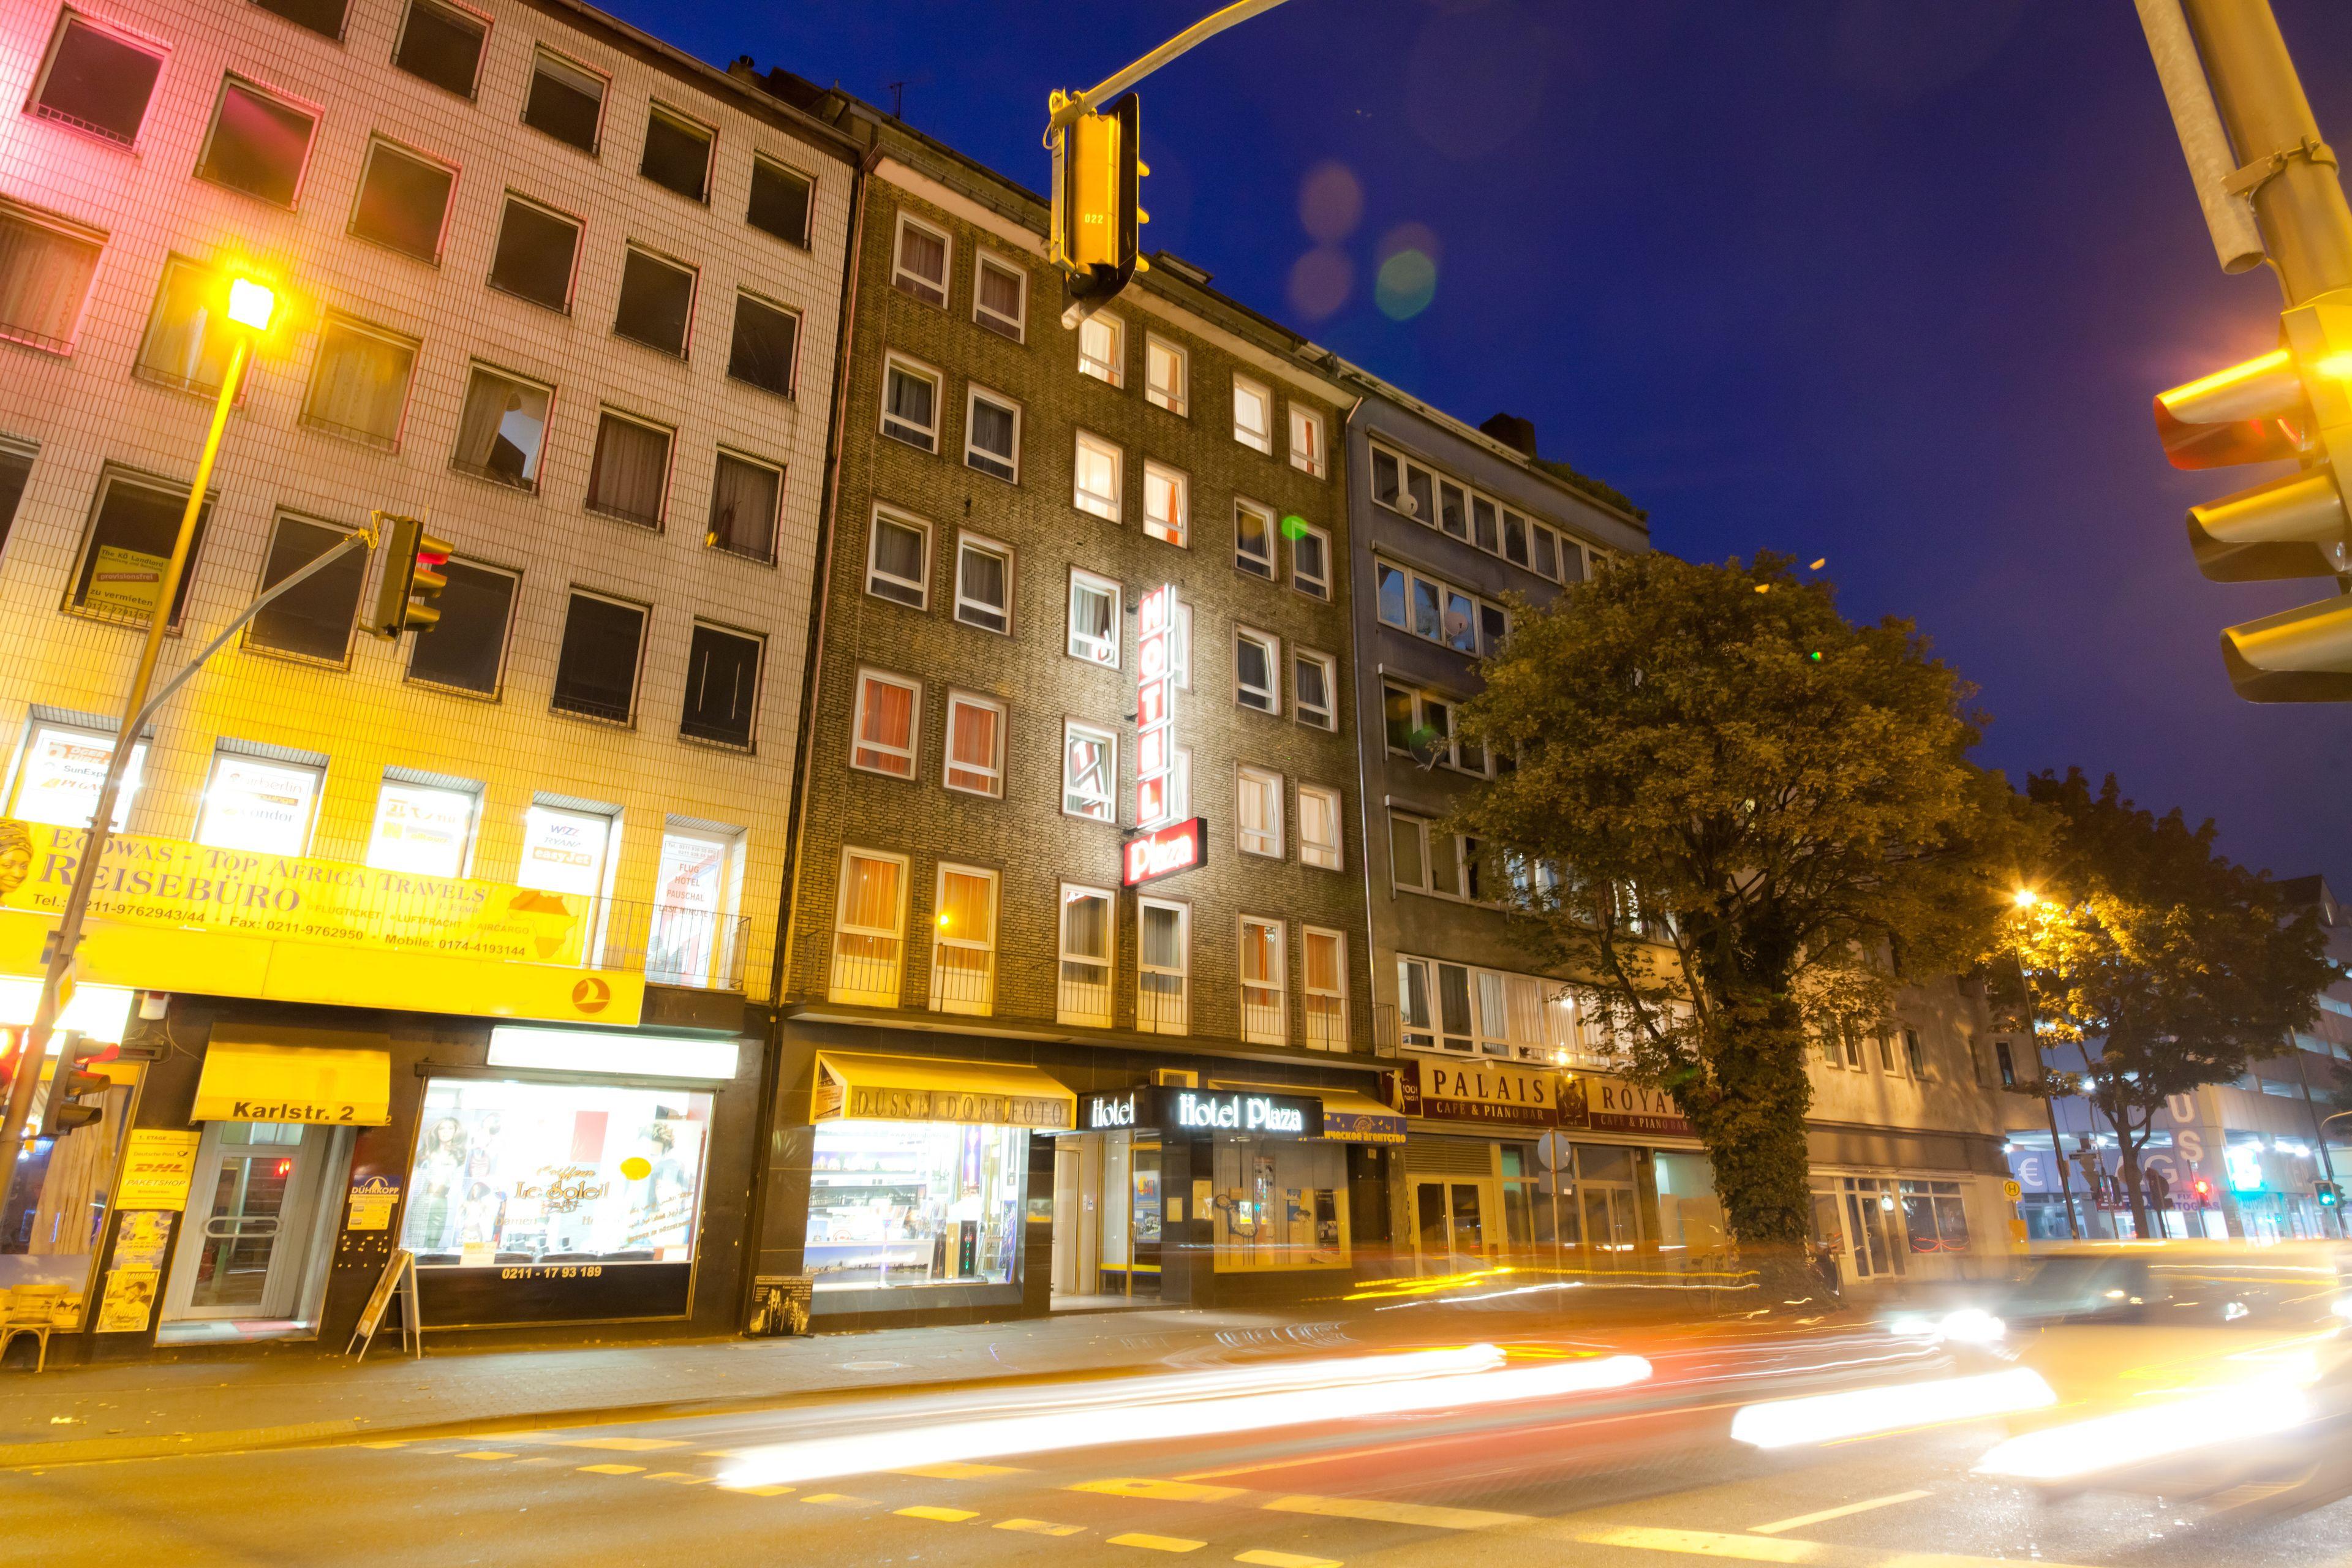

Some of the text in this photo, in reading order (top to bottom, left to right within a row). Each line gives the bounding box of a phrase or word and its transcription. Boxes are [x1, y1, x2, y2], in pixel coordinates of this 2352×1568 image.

[1084, 214, 1104, 224] 022
[131, 556, 164, 567] Landlord
[104, 592, 153, 606] vermieten
[1141, 597, 1163, 821] HOTEL
[241, 808, 295, 823] ondor
[535, 849, 589, 865] easyJet
[1129, 832, 1193, 881] Plaza
[205, 848, 258, 872] TOP
[267, 859, 366, 888] AFRICA
[378, 872, 486, 903] TRAVELS
[679, 863, 699, 874] FLUG
[36, 853, 300, 912] REISEBÜRO
[674, 875, 700, 887] HOTEL
[666, 889, 704, 902] PAUSCHAL
[658, 905, 709, 918] LAST MINUTE
[85, 900, 205, 923] 211-9762943/44
[229, 916, 260, 929] Fax:
[266, 920, 363, 941] 0211-9762950
[385, 934, 434, 948] Mobile:
[439, 939, 526, 956] 0174-4193144
[315, 905, 529, 935] FLUGTICKET LUFTFRACHT AIRCARGO
[1433, 1069, 1545, 1104] PALAIS
[232, 1101, 355, 1121] Karlstr. 2
[1011, 1099, 1062, 1125] FOTO
[1092, 1092, 1134, 1128] Hotel
[1179, 1093, 1302, 1131] Hotel Plaza
[1471, 1104, 1479, 1116] &
[1483, 1104, 1520, 1118] PIANO
[1523, 1107, 1544, 1120] BAR
[1638, 1117, 1668, 1129] PIANO
[1670, 1120, 1688, 1131] BAR
[133, 1163, 185, 1173] DHL
[537, 1165, 597, 1181] Coiffeur
[514, 1180, 611, 1200] Le Soleil
[502, 1267, 532, 1280] 0211
[543, 1267, 559, 1278] 17
[561, 1266, 577, 1278] 93
[580, 1265, 602, 1277] 189
